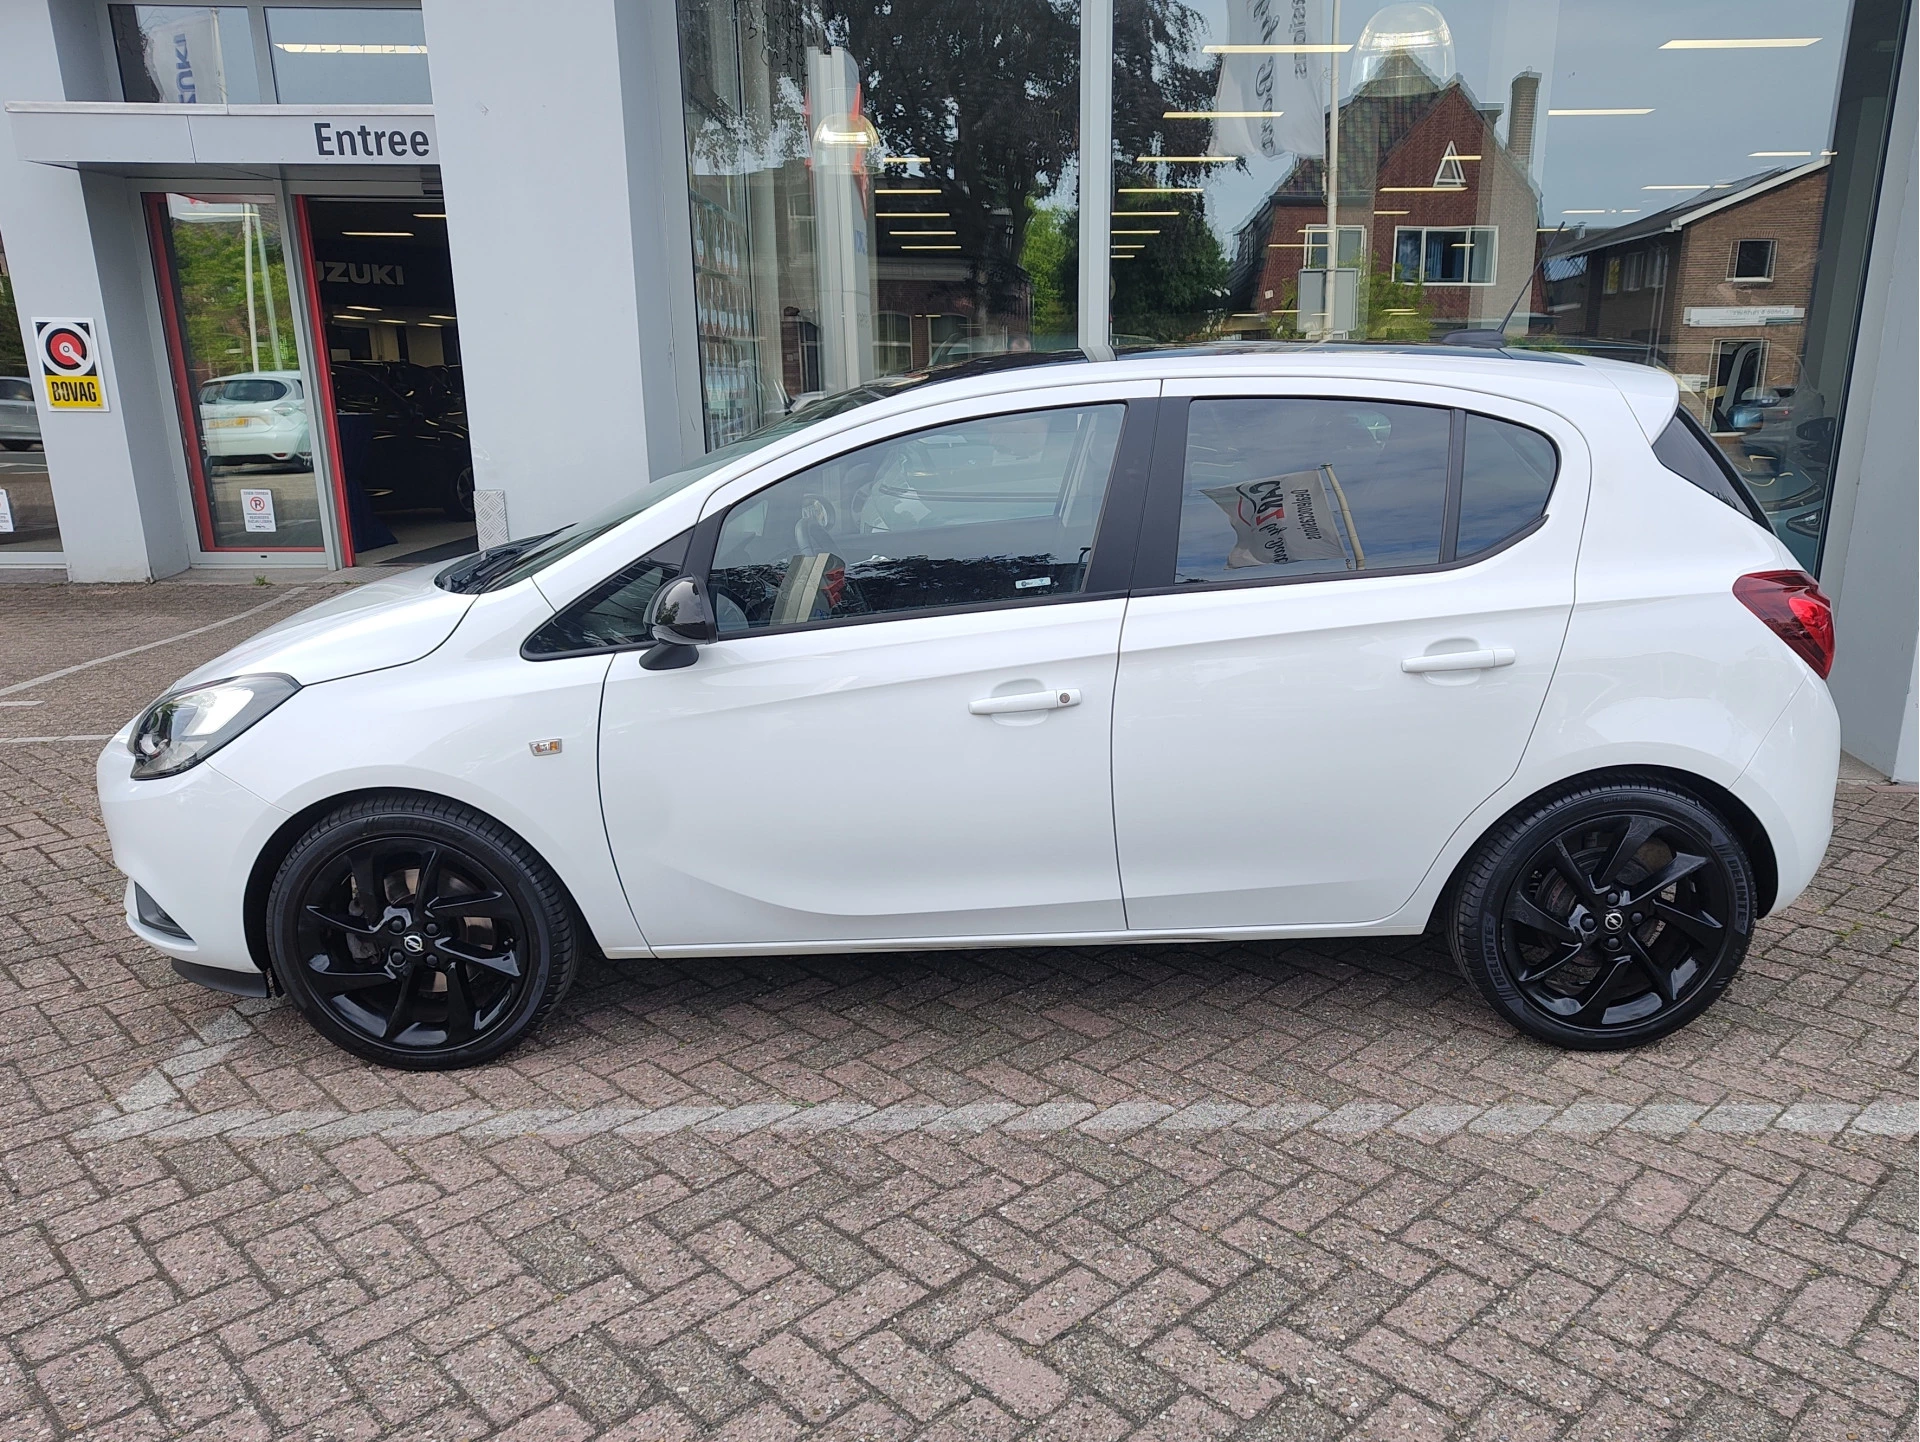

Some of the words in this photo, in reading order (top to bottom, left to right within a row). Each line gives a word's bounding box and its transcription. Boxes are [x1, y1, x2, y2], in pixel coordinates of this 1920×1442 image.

[314, 122, 430, 156] Entree
[51, 381, 97, 402] BOVAG
[1727, 860, 1748, 921] DELINTE
[1484, 925, 1507, 987] DELINTE
